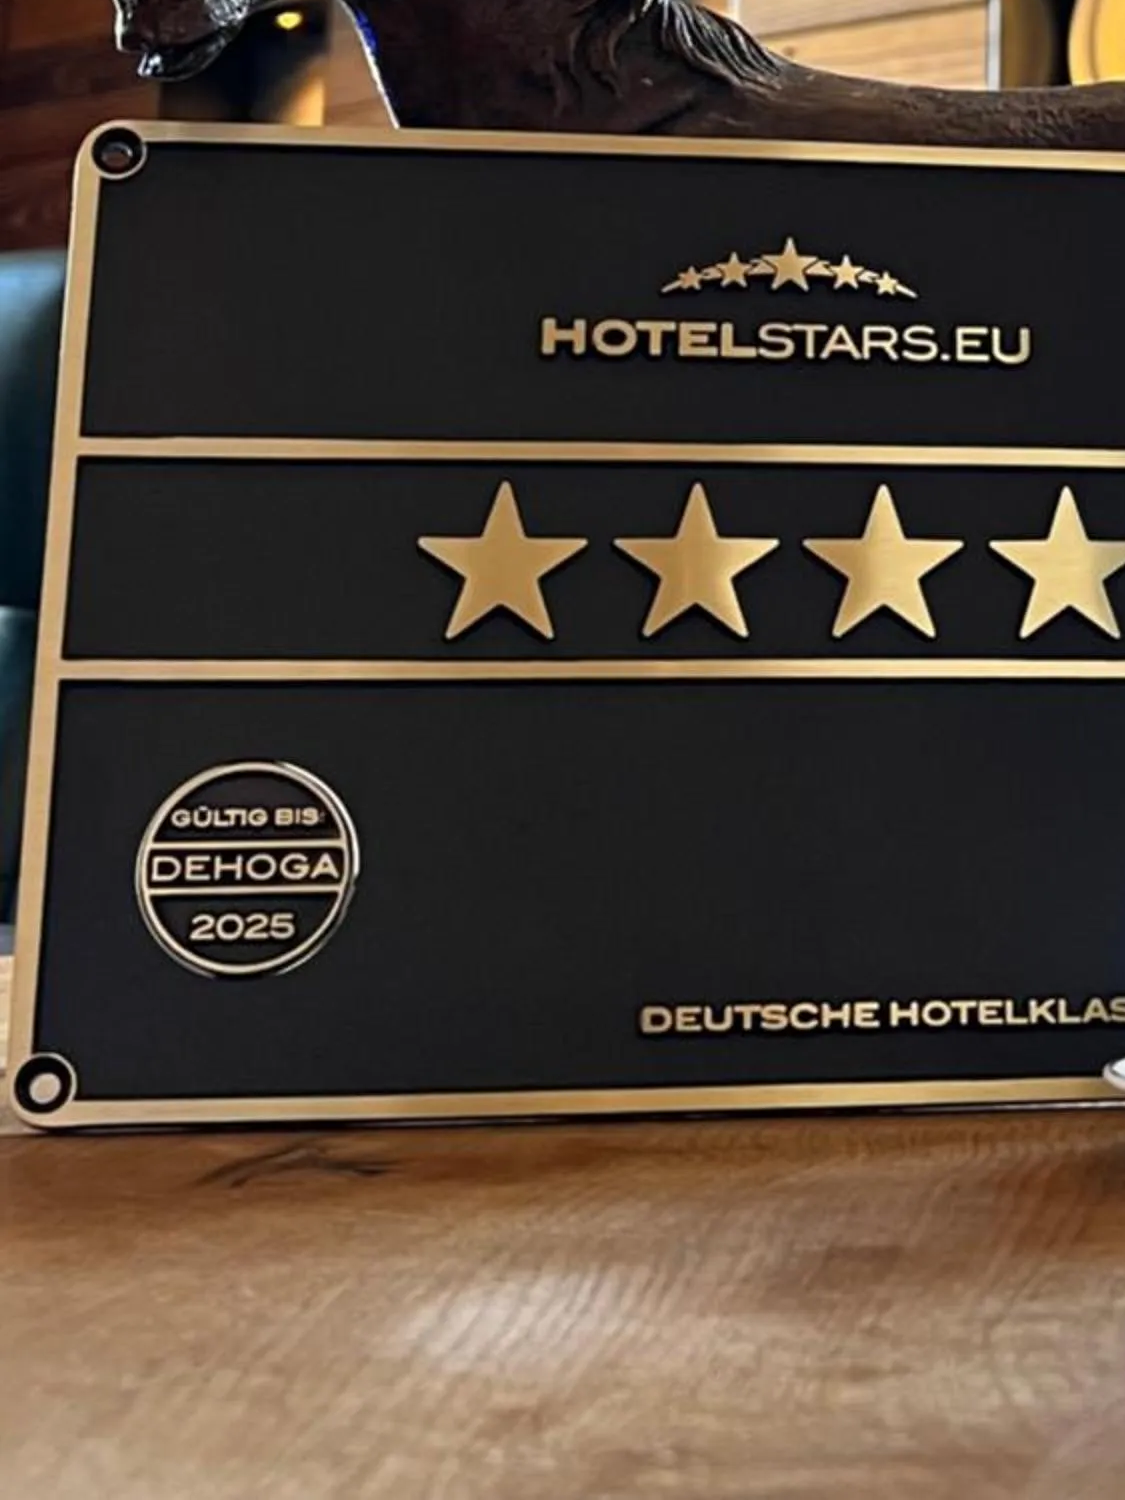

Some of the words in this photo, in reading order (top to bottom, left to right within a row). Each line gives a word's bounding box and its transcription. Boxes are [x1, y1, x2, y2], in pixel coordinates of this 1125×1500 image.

[540, 316, 1032, 366] HOTELSTARS.EU
[170, 806, 268, 828] GÜLTIG
[150, 853, 340, 882] DEHOGA
[189, 913, 296, 941] 2025
[640, 1001, 881, 1034] DEUTSCHE
